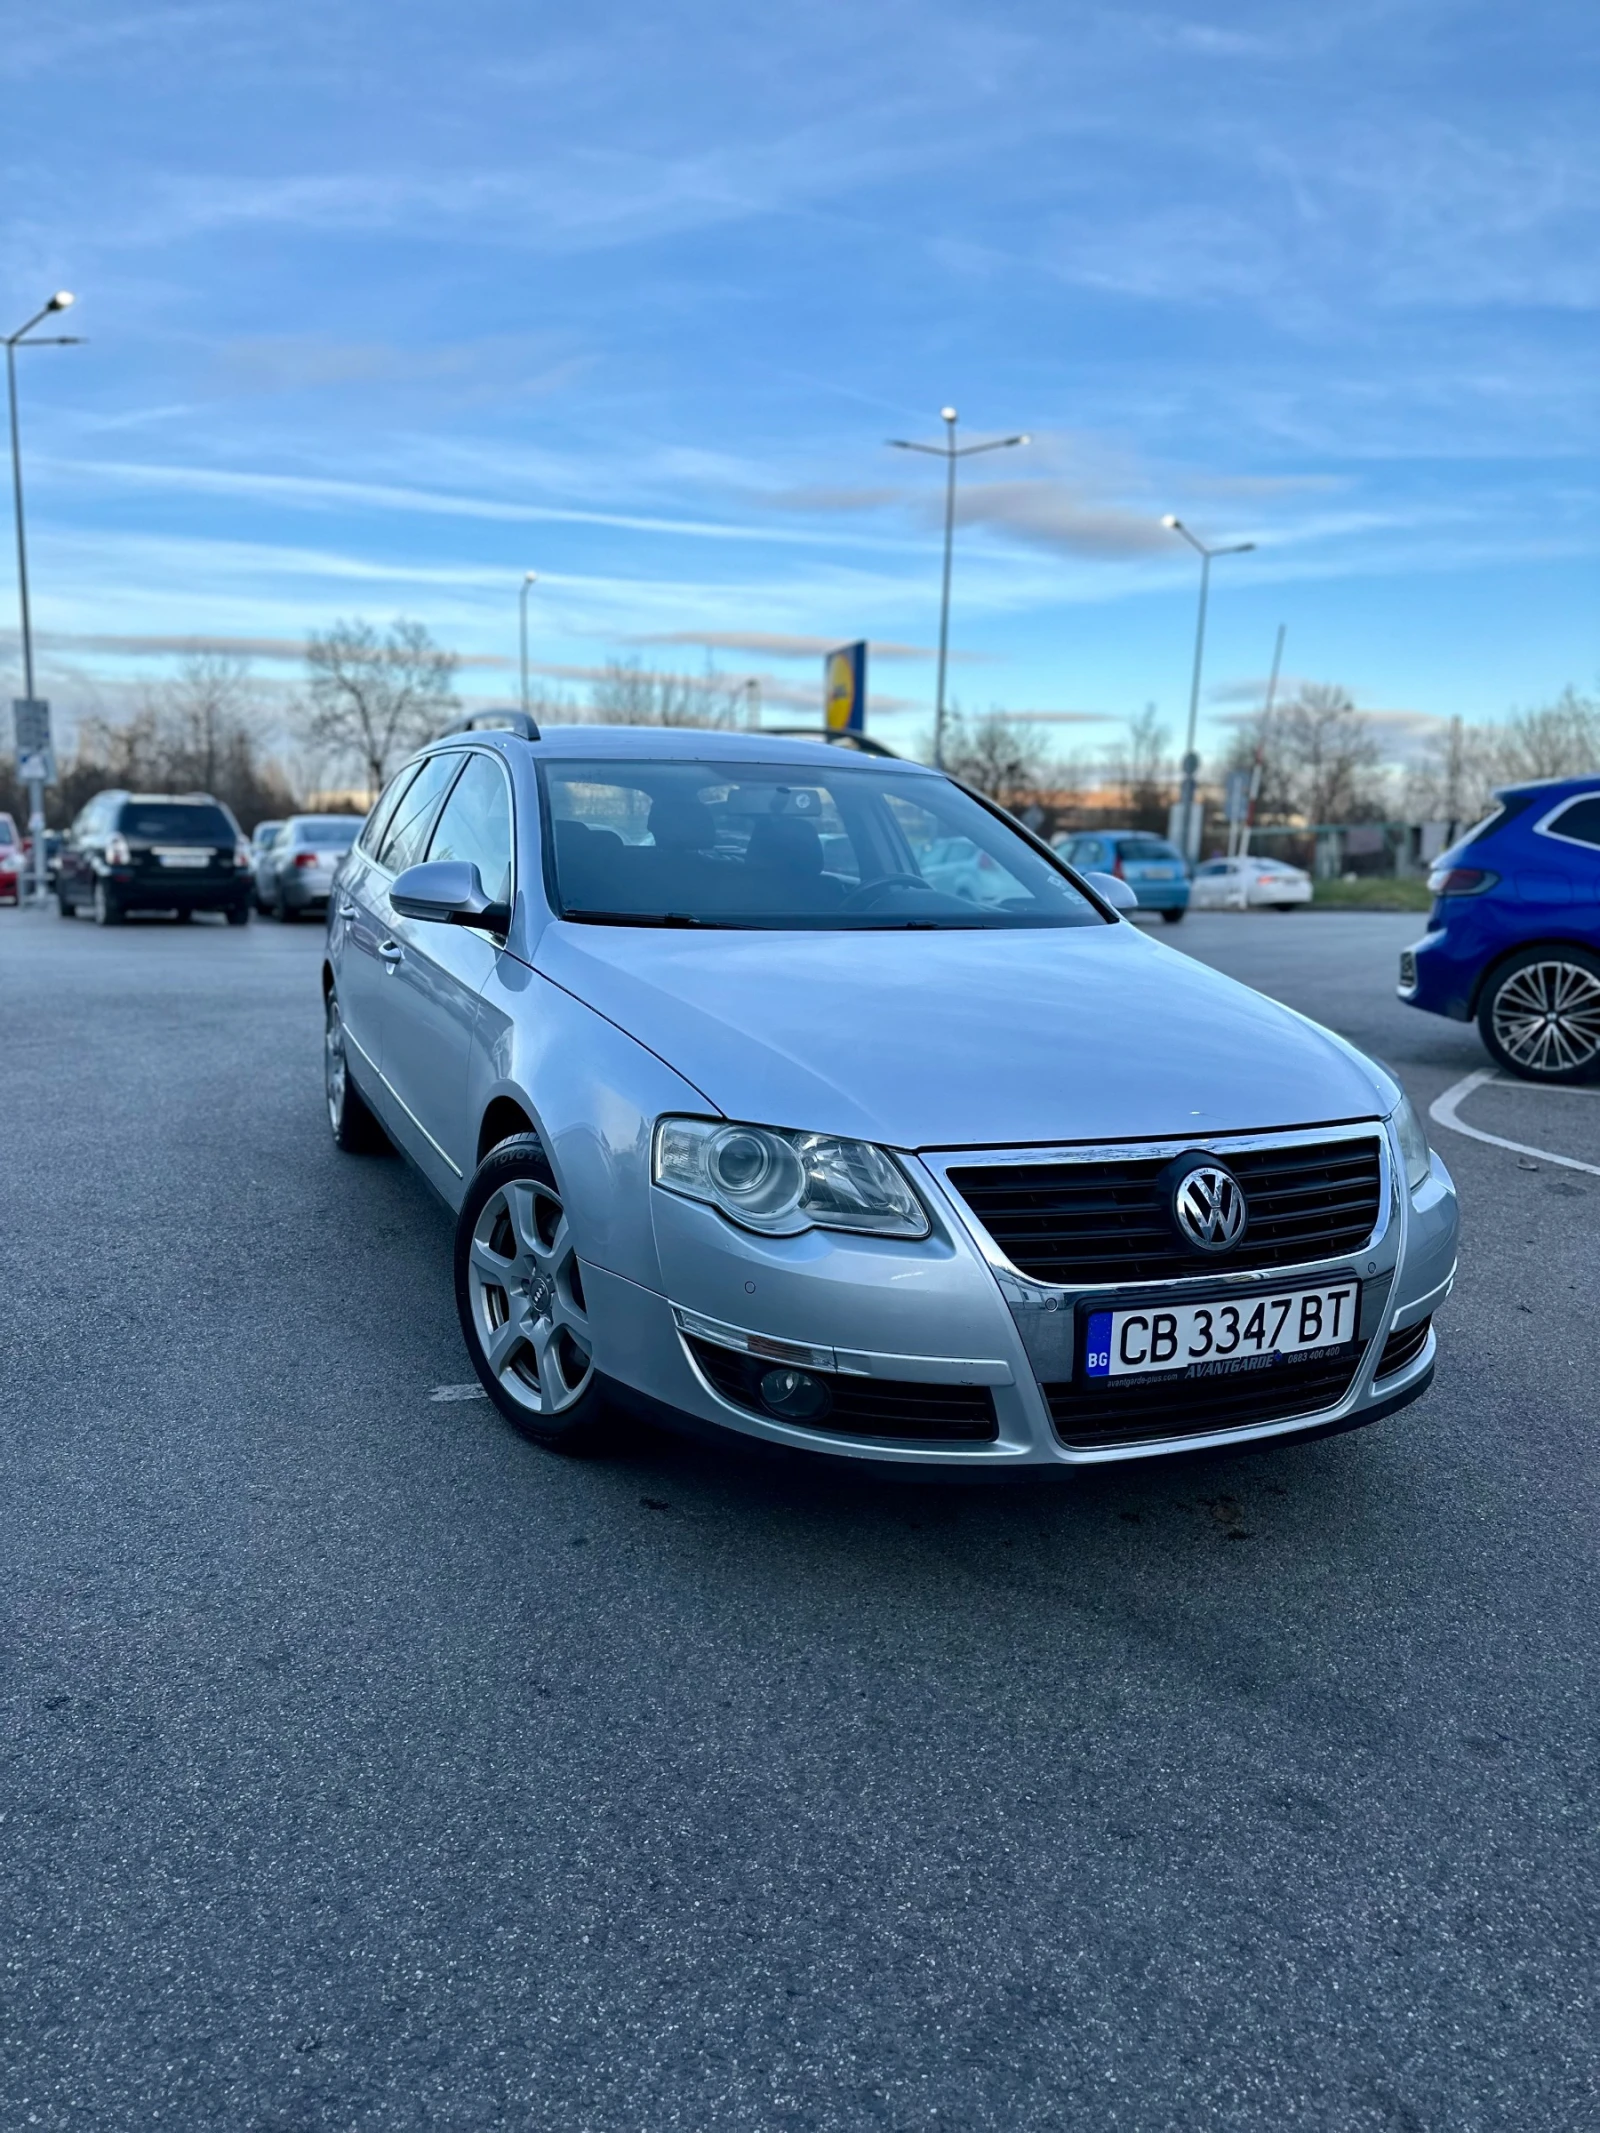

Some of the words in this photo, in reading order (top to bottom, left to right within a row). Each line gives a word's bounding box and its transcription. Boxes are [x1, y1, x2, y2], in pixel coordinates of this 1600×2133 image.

[493, 1148, 527, 1167] TOYO
[1119, 1313, 1178, 1365] CB
[1188, 1299, 1292, 1357] 3347
[1298, 1290, 1351, 1343] BT
[1088, 1352, 1108, 1369] BG
[1287, 1352, 1308, 1364] 0883
[1309, 1349, 1324, 1360] 400
[1325, 1346, 1340, 1357] 400
[1184, 1354, 1273, 1379] AVANTGARDE
[1107, 1373, 1178, 1388] avantgarde-plus.com
